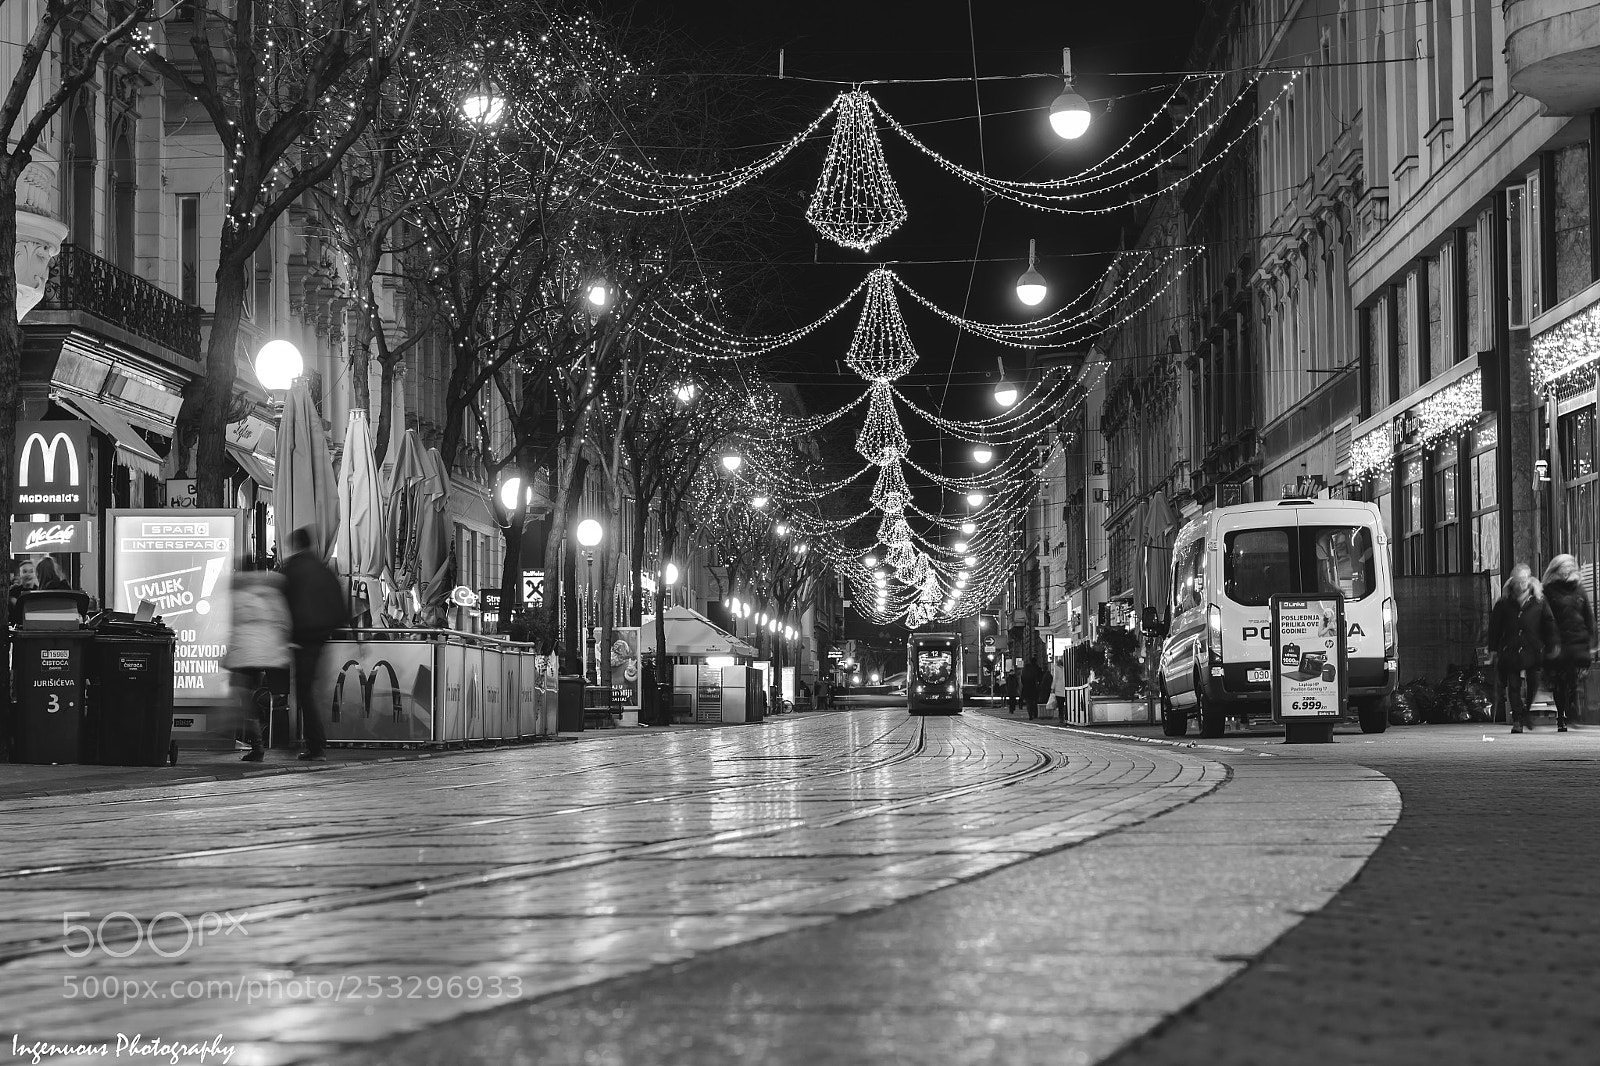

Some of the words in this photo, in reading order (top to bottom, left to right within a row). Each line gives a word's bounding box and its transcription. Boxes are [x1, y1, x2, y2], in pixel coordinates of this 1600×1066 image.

[19, 494, 79, 503] McDonald's
[151, 526, 194, 534] SPAR
[132, 541, 214, 549] INTERSPAR
[134, 577, 185, 599] UVIJEK
[180, 629, 196, 642] OD
[33, 677, 75, 687] JURIŠIĆEVA
[47, 693, 60, 713] 3
[1292, 701, 1322, 710] 6.999
